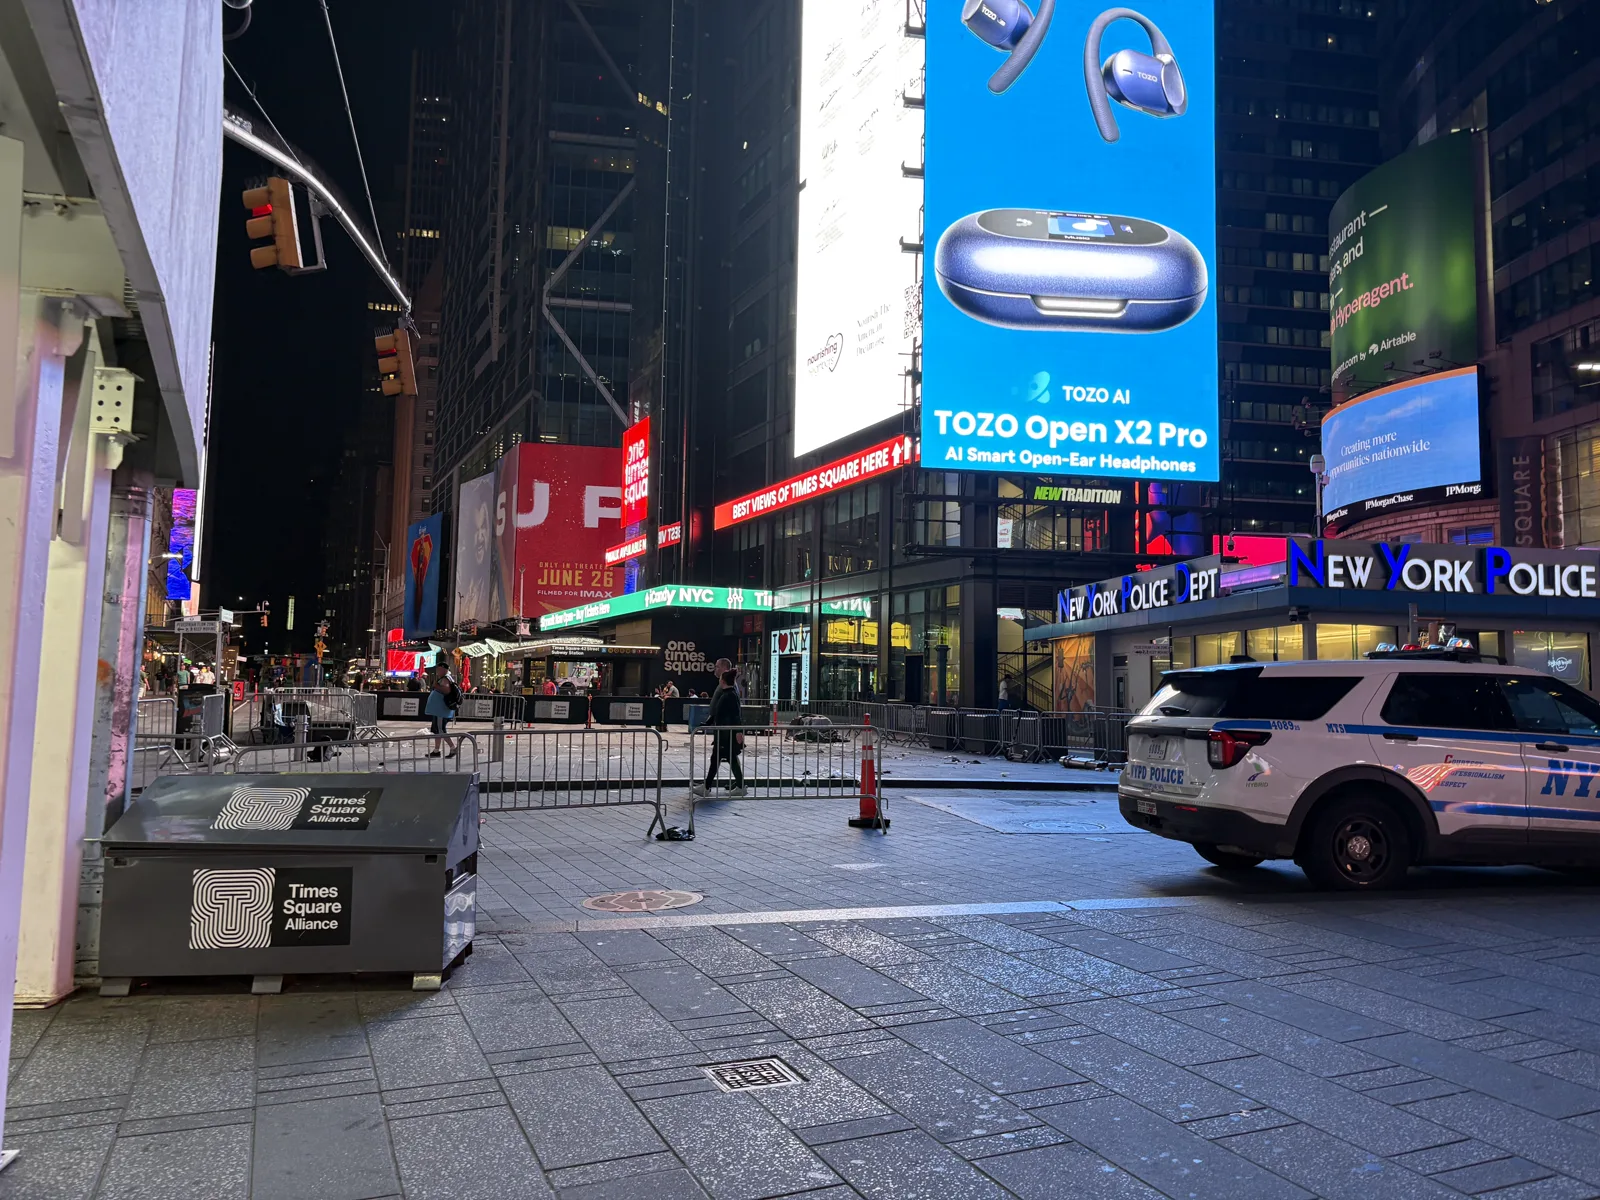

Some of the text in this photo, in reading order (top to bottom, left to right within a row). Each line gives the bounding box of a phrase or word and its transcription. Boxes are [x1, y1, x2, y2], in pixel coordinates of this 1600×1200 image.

[981, 6, 997, 21] TOZO
[1137, 71, 1158, 82] TOZO
[1343, 236, 1364, 267] and
[1335, 272, 1414, 328] Hyperagent.
[807, 342, 838, 366] nourishing
[1359, 351, 1367, 361] by
[1380, 331, 1417, 352] Airtable
[1062, 385, 1130, 405] TOZO AI
[934, 410, 1208, 448] TOZO Open X2 Pro
[627, 438, 645, 465] one
[1341, 431, 1397, 457] Creating more
[1371, 438, 1431, 463] nationwide
[945, 446, 1196, 473] AI Smart Open-Ear Headphones
[732, 447, 889, 519] BEST VIEWS OF TIMES SQUARE HERE
[1365, 493, 1414, 511] JPMorganChase
[1512, 455, 1533, 546] SQUARE
[538, 569, 613, 587] JUNE 26
[1380, 542, 1474, 592] YORK
[1485, 546, 1597, 598] POLICE
[580, 590, 613, 598] IMAX
[649, 587, 714, 606] iCandy NYC
[667, 640, 696, 652] one
[772, 633, 778, 654] I
[789, 630, 811, 652] NY
[664, 649, 706, 662] times
[664, 660, 715, 676] square
[1271, 720, 1294, 731] 4089
[1326, 722, 1345, 734] MTS
[1130, 764, 1184, 785] NYPD POLICE
[1540, 757, 1600, 797] NY
[320, 795, 366, 805] Times
[307, 814, 360, 823] Alliance
[309, 804, 366, 816] Square
[288, 883, 338, 898] Times
[283, 898, 342, 917] Square
[284, 917, 339, 931] Alliance
